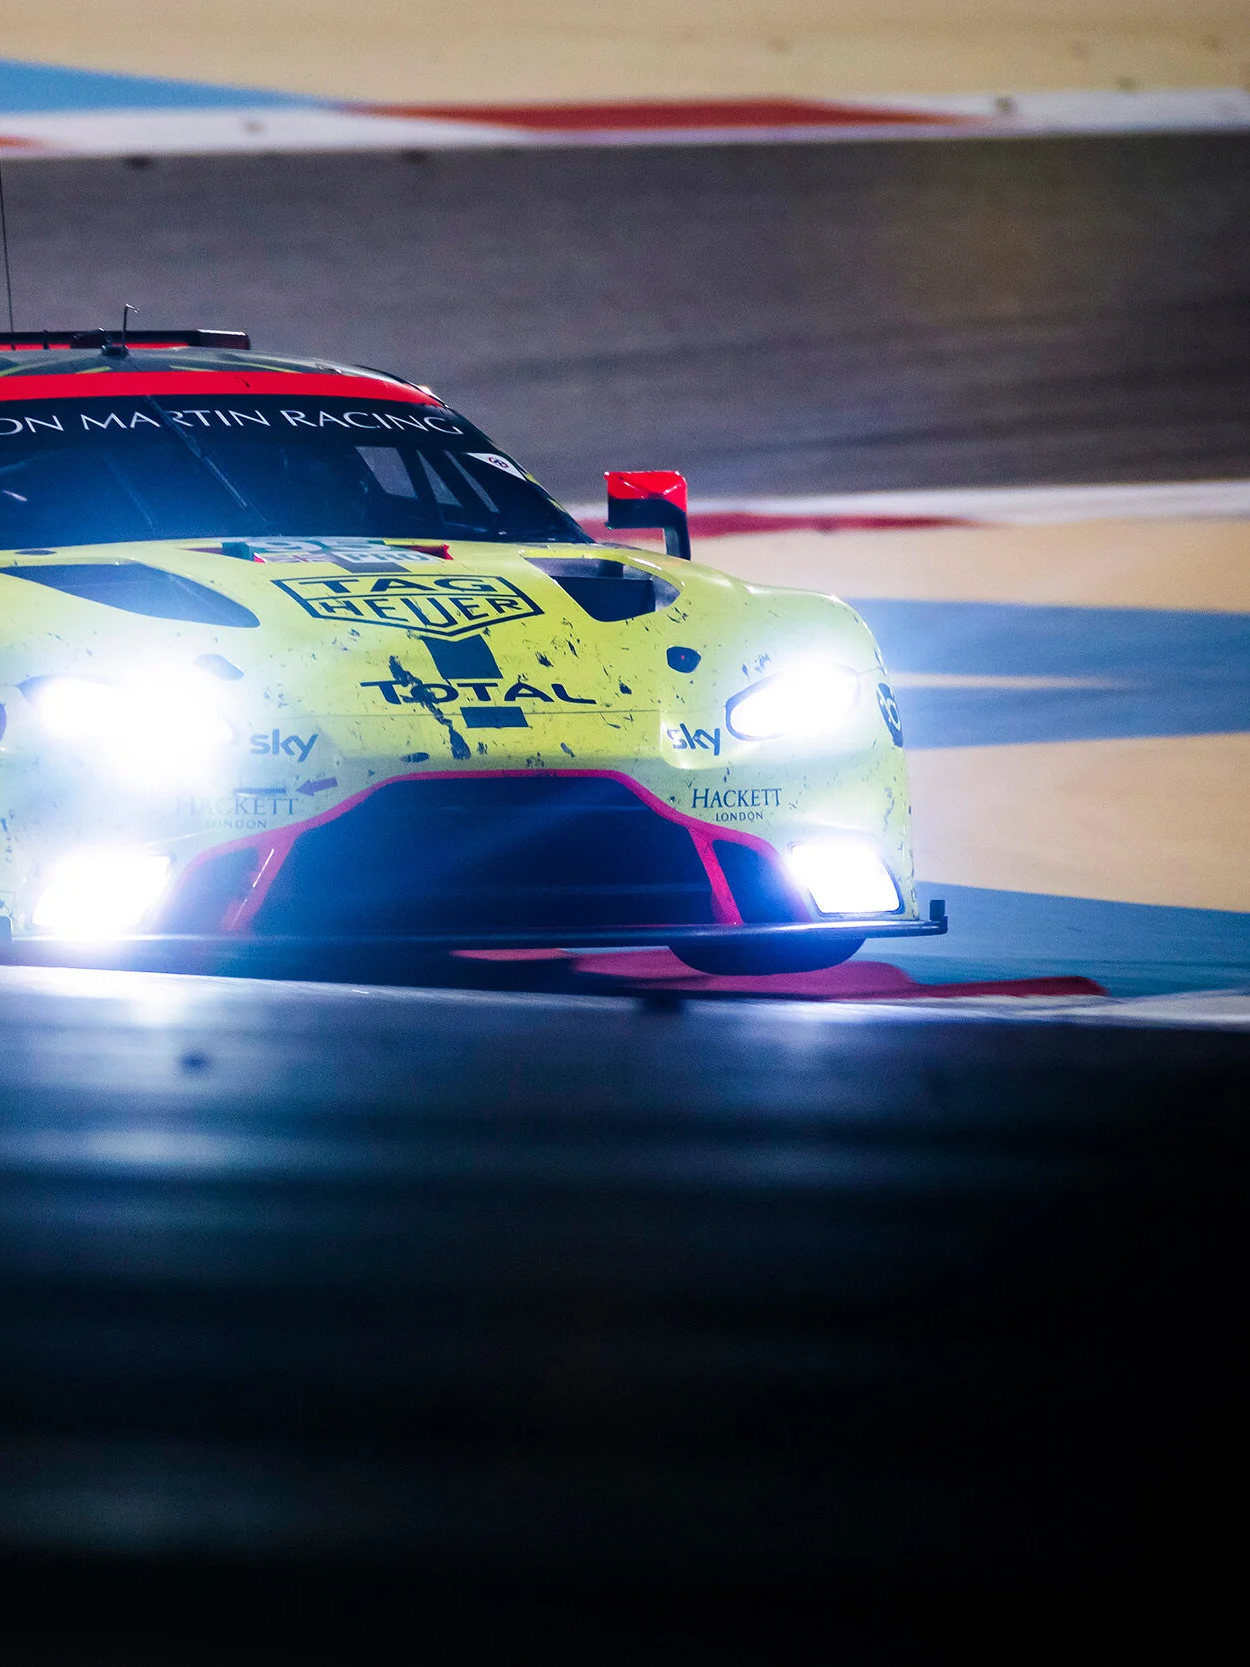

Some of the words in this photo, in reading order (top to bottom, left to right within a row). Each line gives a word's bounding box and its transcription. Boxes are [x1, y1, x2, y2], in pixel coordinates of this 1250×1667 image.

[81, 410, 270, 431] MARTIN
[280, 410, 463, 435] RACING
[298, 578, 498, 593] TAG
[318, 597, 520, 628] HEUER
[360, 681, 597, 705] TOTAL
[250, 728, 319, 763] sky
[667, 723, 720, 756] sky
[691, 788, 783, 809] HACKETT
[715, 812, 764, 822] LONDON
